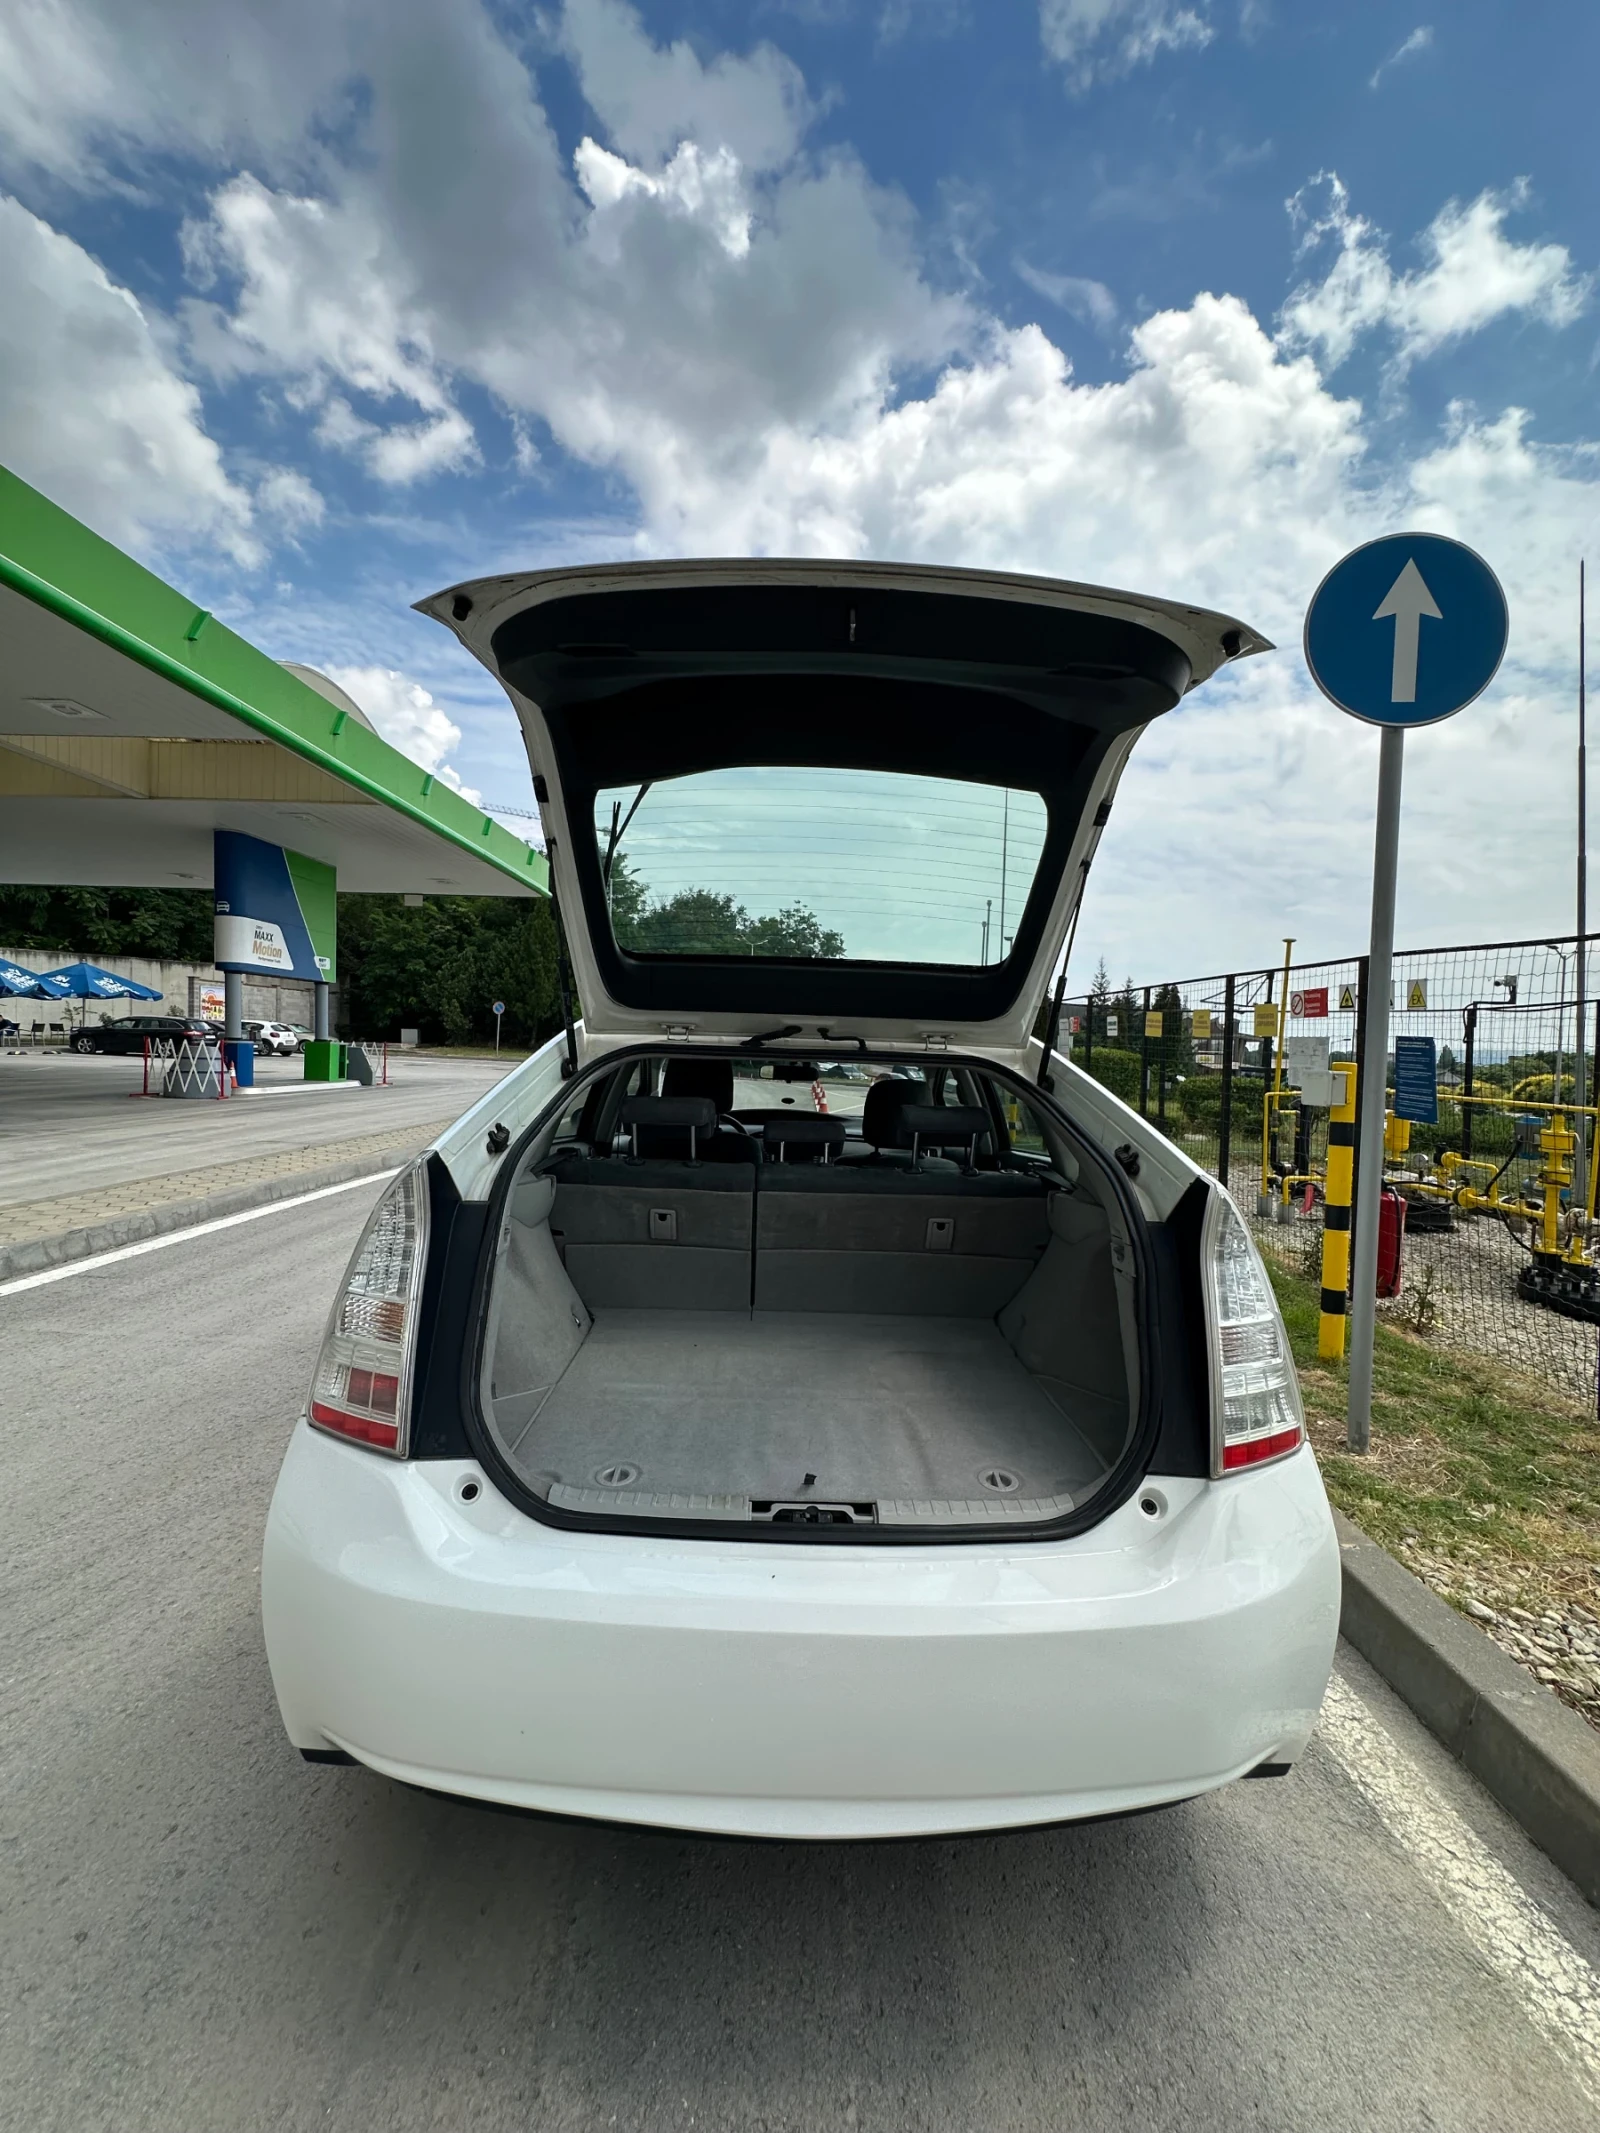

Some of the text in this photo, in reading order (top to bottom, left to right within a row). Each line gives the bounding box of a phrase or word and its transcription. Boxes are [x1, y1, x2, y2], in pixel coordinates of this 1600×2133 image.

[254, 930, 274, 942] MAXX
[252, 940, 282, 958] Motion
[1411, 994, 1422, 1005] EX
